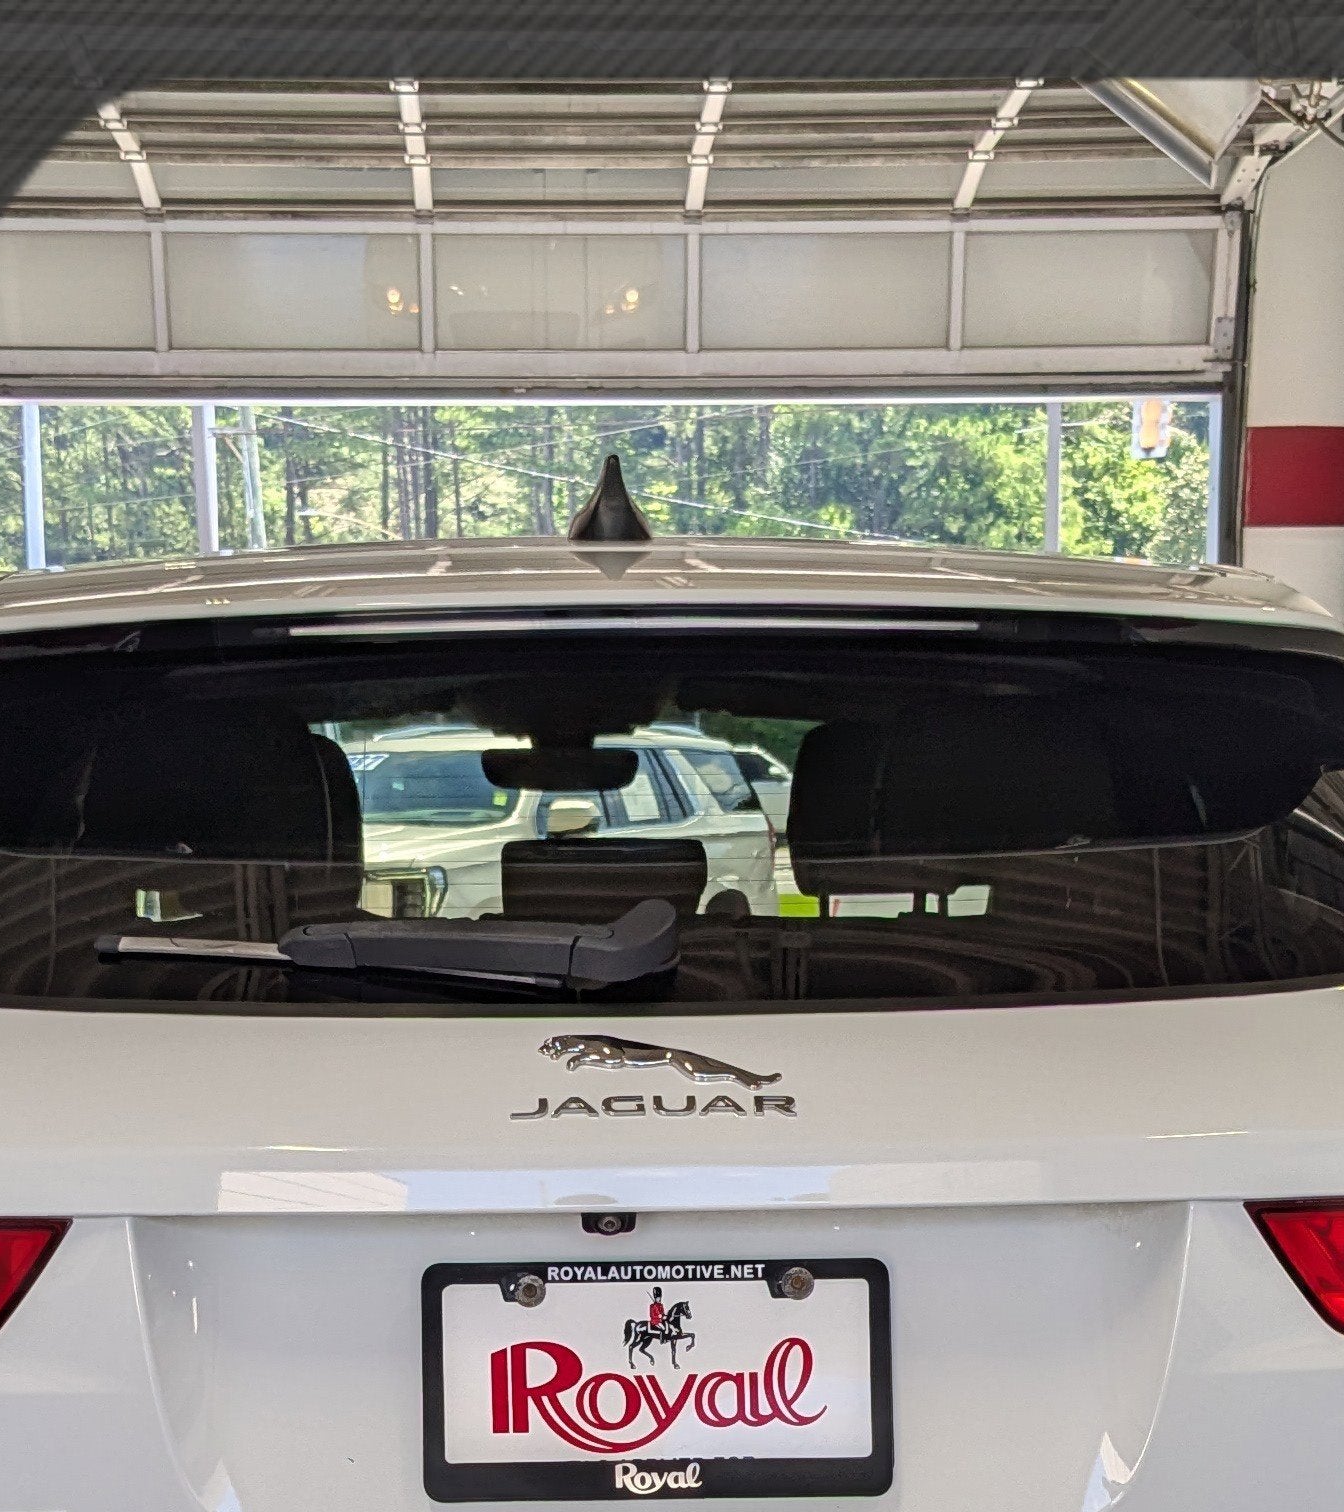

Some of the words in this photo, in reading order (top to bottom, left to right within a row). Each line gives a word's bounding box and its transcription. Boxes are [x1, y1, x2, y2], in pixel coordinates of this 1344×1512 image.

[510, 1095, 797, 1120] JAGUAR
[547, 1264, 766, 1281] ROYALAUTOMOTIVE.NET
[490, 1337, 827, 1454] Royal
[614, 1462, 703, 1495] Royal
